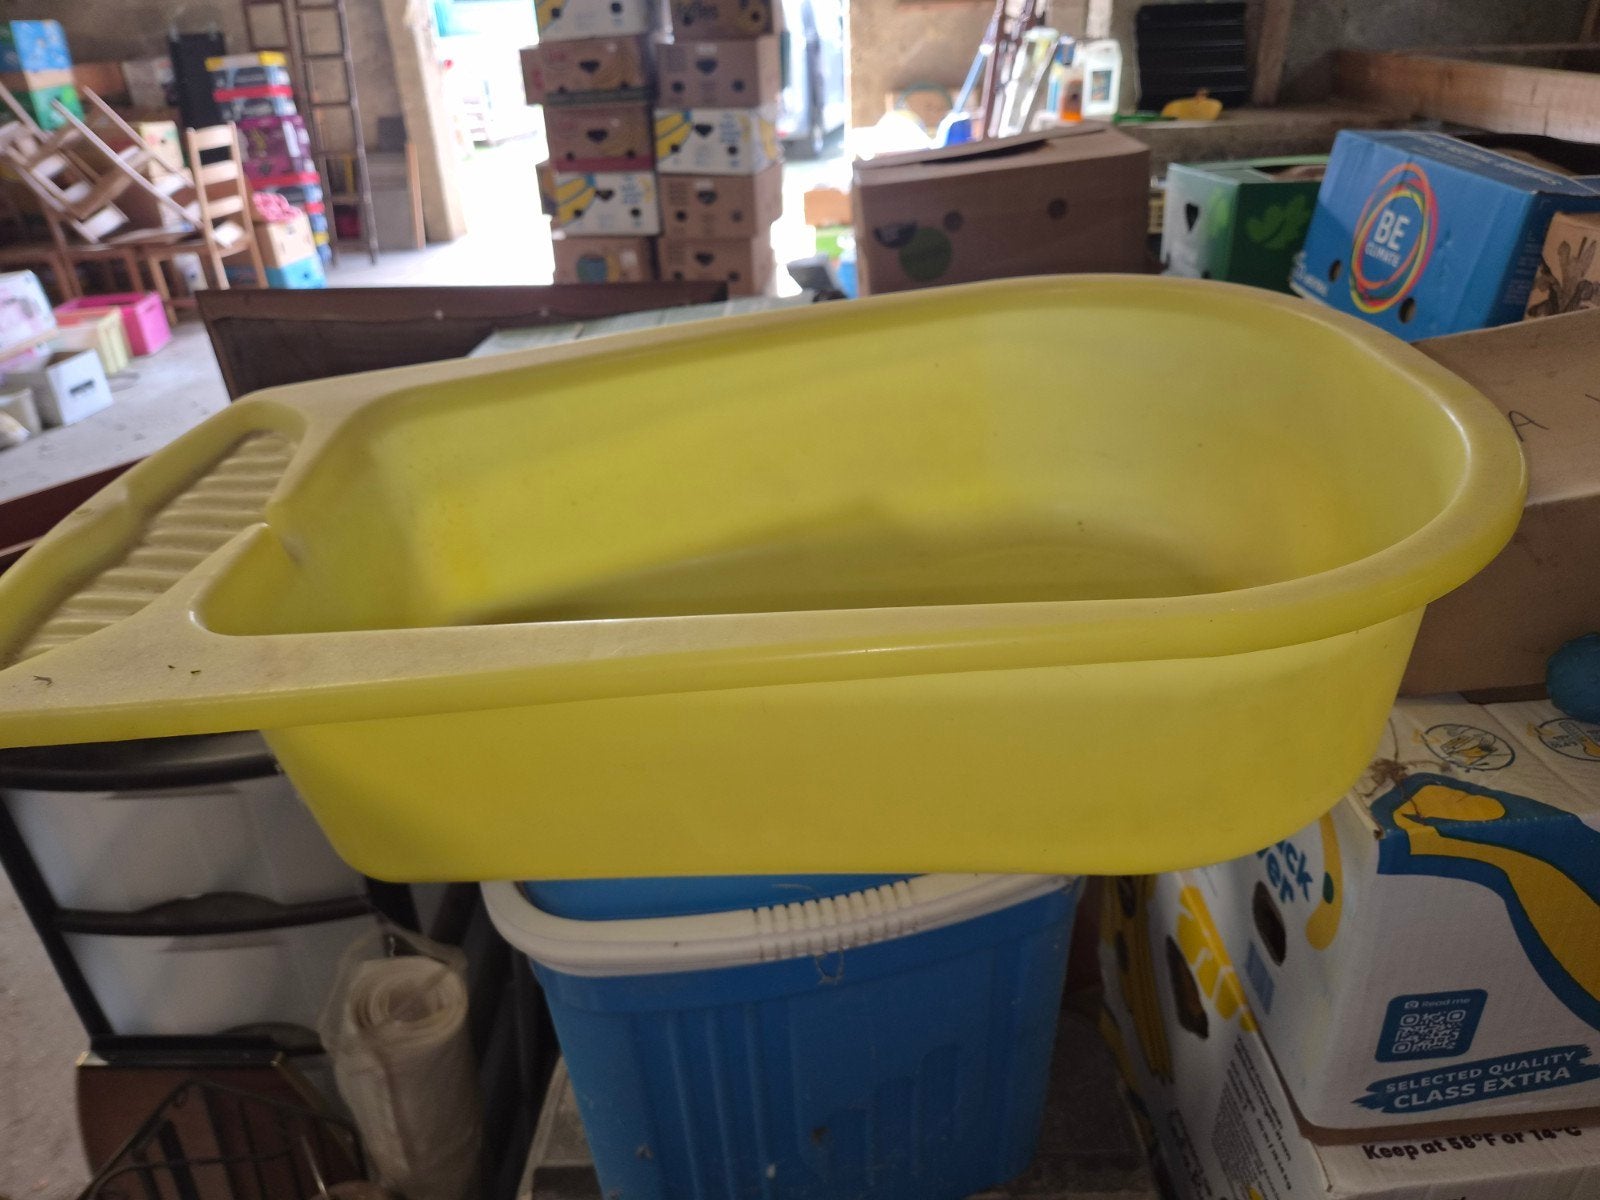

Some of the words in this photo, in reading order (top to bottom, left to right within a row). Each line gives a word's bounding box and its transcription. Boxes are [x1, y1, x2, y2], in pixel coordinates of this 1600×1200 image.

[1374, 210, 1410, 250] BE
[1508, 410, 1550, 442] A
[1421, 998, 1451, 1008] Read
[1385, 1068, 1482, 1094] SELECTED
[1488, 1051, 1576, 1076] QUALITY
[1393, 1083, 1476, 1109] CLASS
[1483, 1066, 1571, 1093] EXTRA
[1362, 1144, 1419, 1160] Keep
[1420, 1139, 1447, 1154] at
[1501, 1131, 1525, 1145] or
